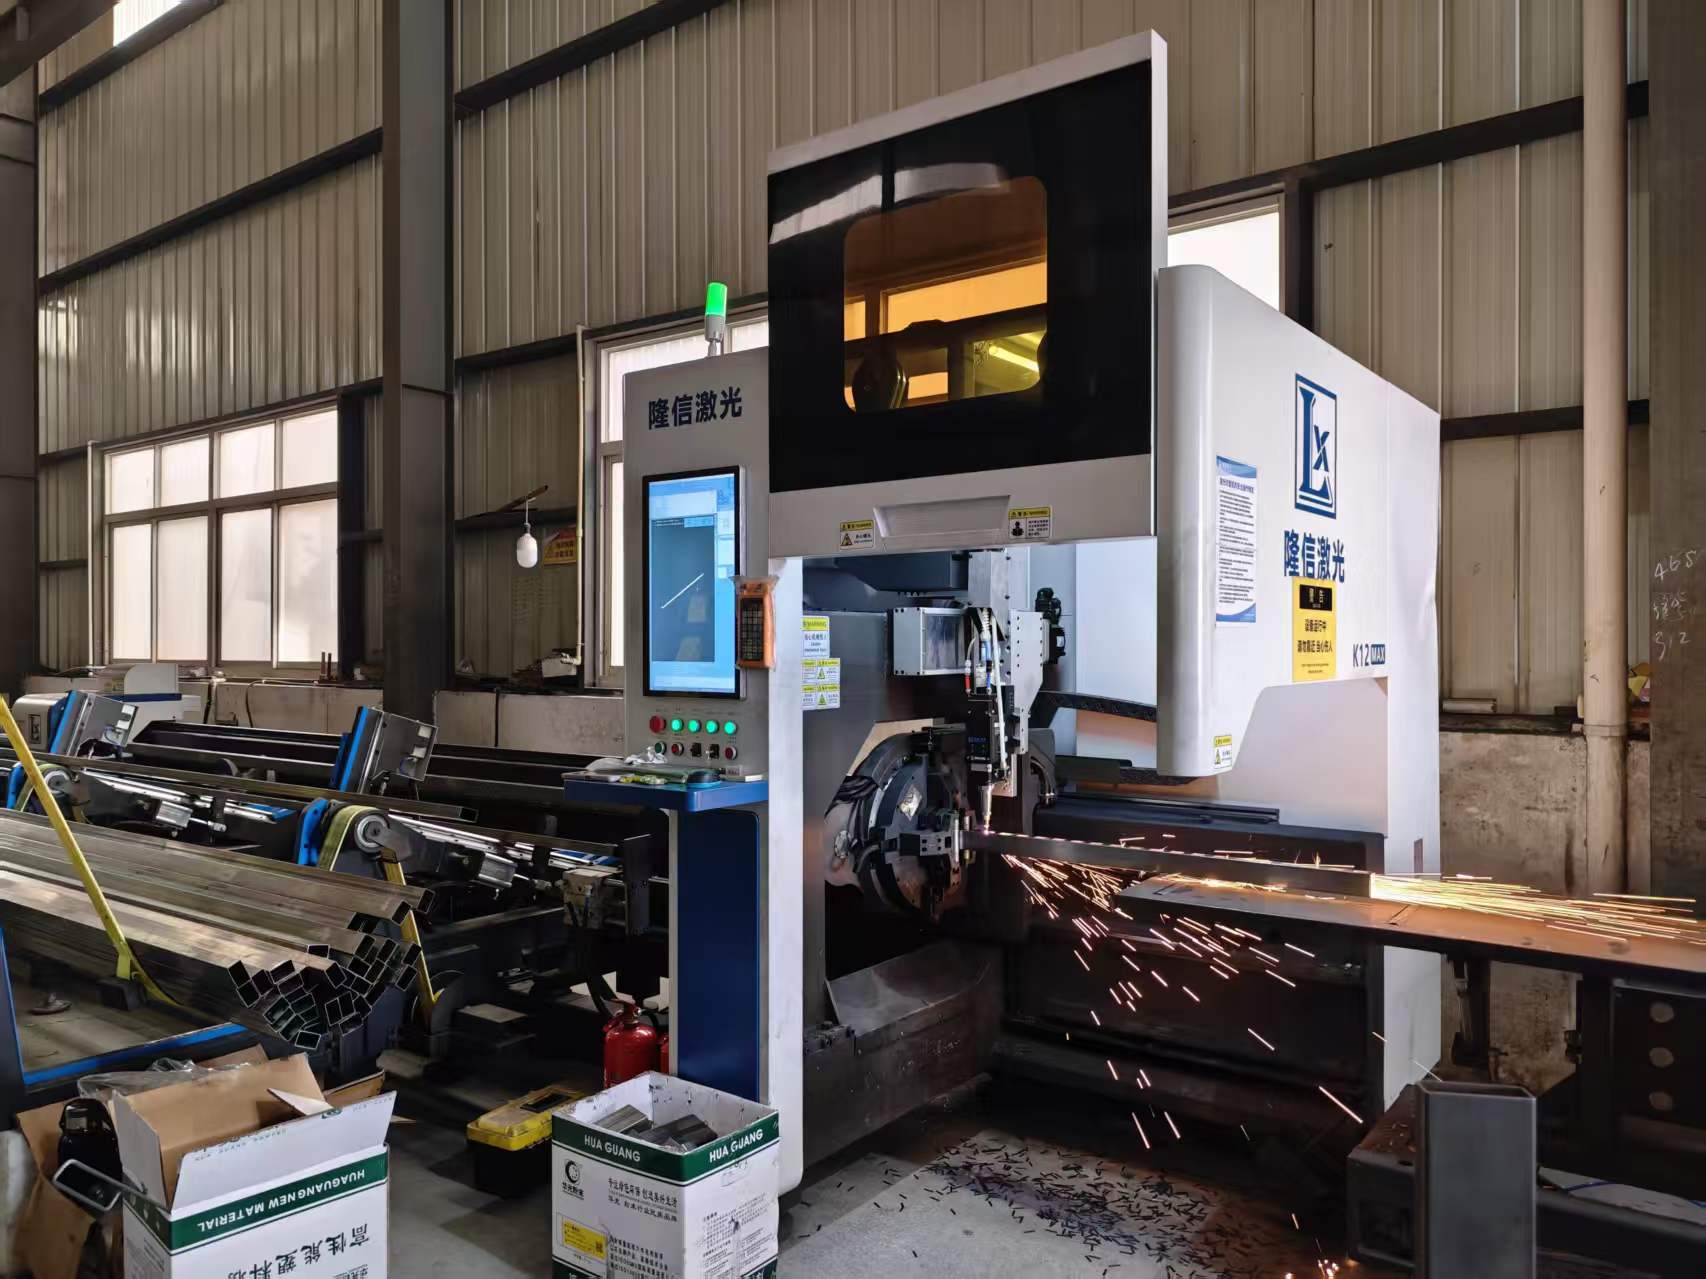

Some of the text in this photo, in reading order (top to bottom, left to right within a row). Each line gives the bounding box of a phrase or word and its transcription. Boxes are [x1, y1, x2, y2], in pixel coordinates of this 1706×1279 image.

[649, 386, 742, 430] 隆信激光
[1284, 529, 1345, 583] 隆信激光
[1352, 643, 1386, 668] K12 MAX
[584, 1134, 641, 1163] HUA GUANG
[709, 1128, 763, 1163] HUA GUANG
[197, 1168, 365, 1232] HUAGUANG NEW MATERIAL
